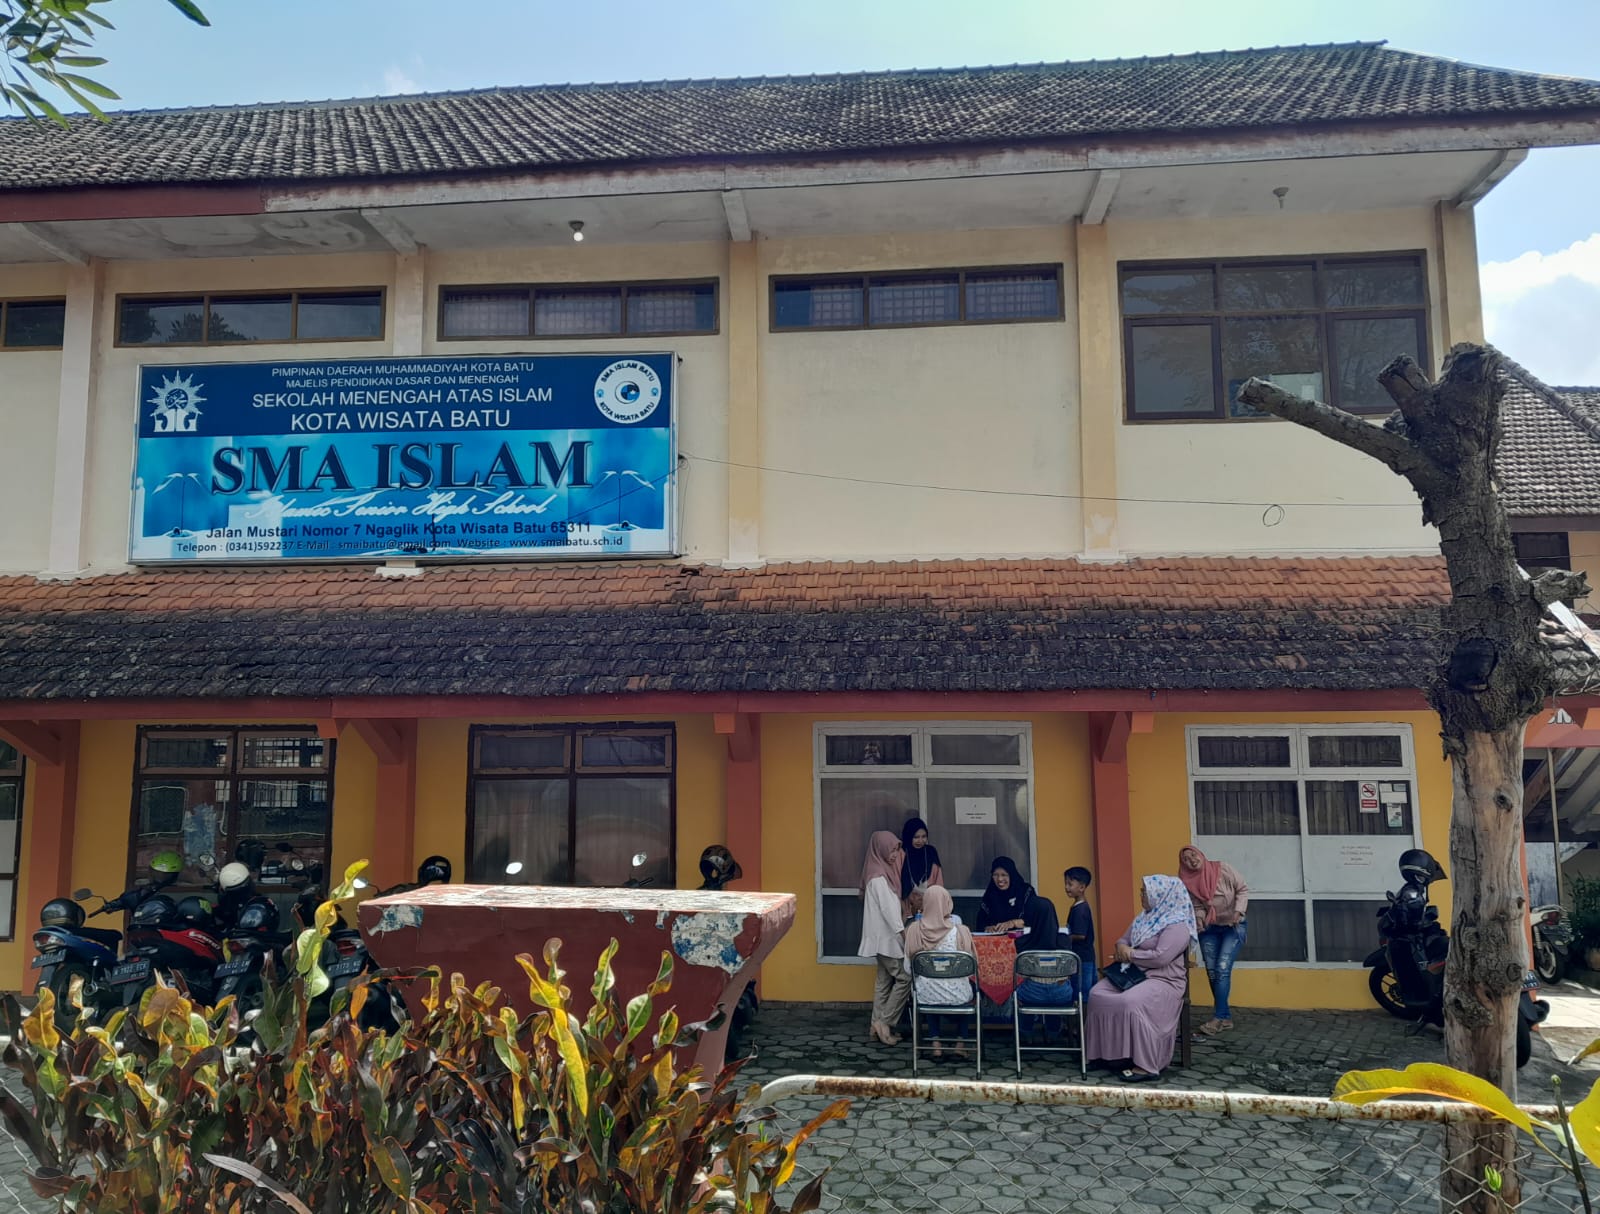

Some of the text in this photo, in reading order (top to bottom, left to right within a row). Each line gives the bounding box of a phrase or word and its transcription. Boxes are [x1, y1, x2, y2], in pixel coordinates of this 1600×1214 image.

[271, 361, 534, 377] PIMPINAN DAERAH MUHAMMADIYAH KOTA BATU
[600, 362, 655, 383] SMA ISLAM BATU
[286, 374, 519, 388] MAJELIS PENDIDIKAN DASAR DAN MENENGAH
[252, 387, 552, 408] SEKOLAH MENENGAH ATAS ISLAM
[600, 401, 614, 417] KOTA
[639, 401, 655, 417] BATU
[291, 409, 510, 431] KOTA WISATA BATU
[211, 440, 593, 496] SMA ISLAM
[412, 491, 476, 523] High
[472, 490, 557, 515] School
[206, 521, 591, 539] Jalan Mustari Nomor 7 Ngaglik Kota Wisata Batu 65311
[176, 543, 217, 553] Telepon
[225, 540, 294, 553] (0341)592237
[296, 540, 329, 550] E-Mail
[457, 537, 501, 548] Website
[509, 536, 624, 547] www.smaibatu.sch.id
